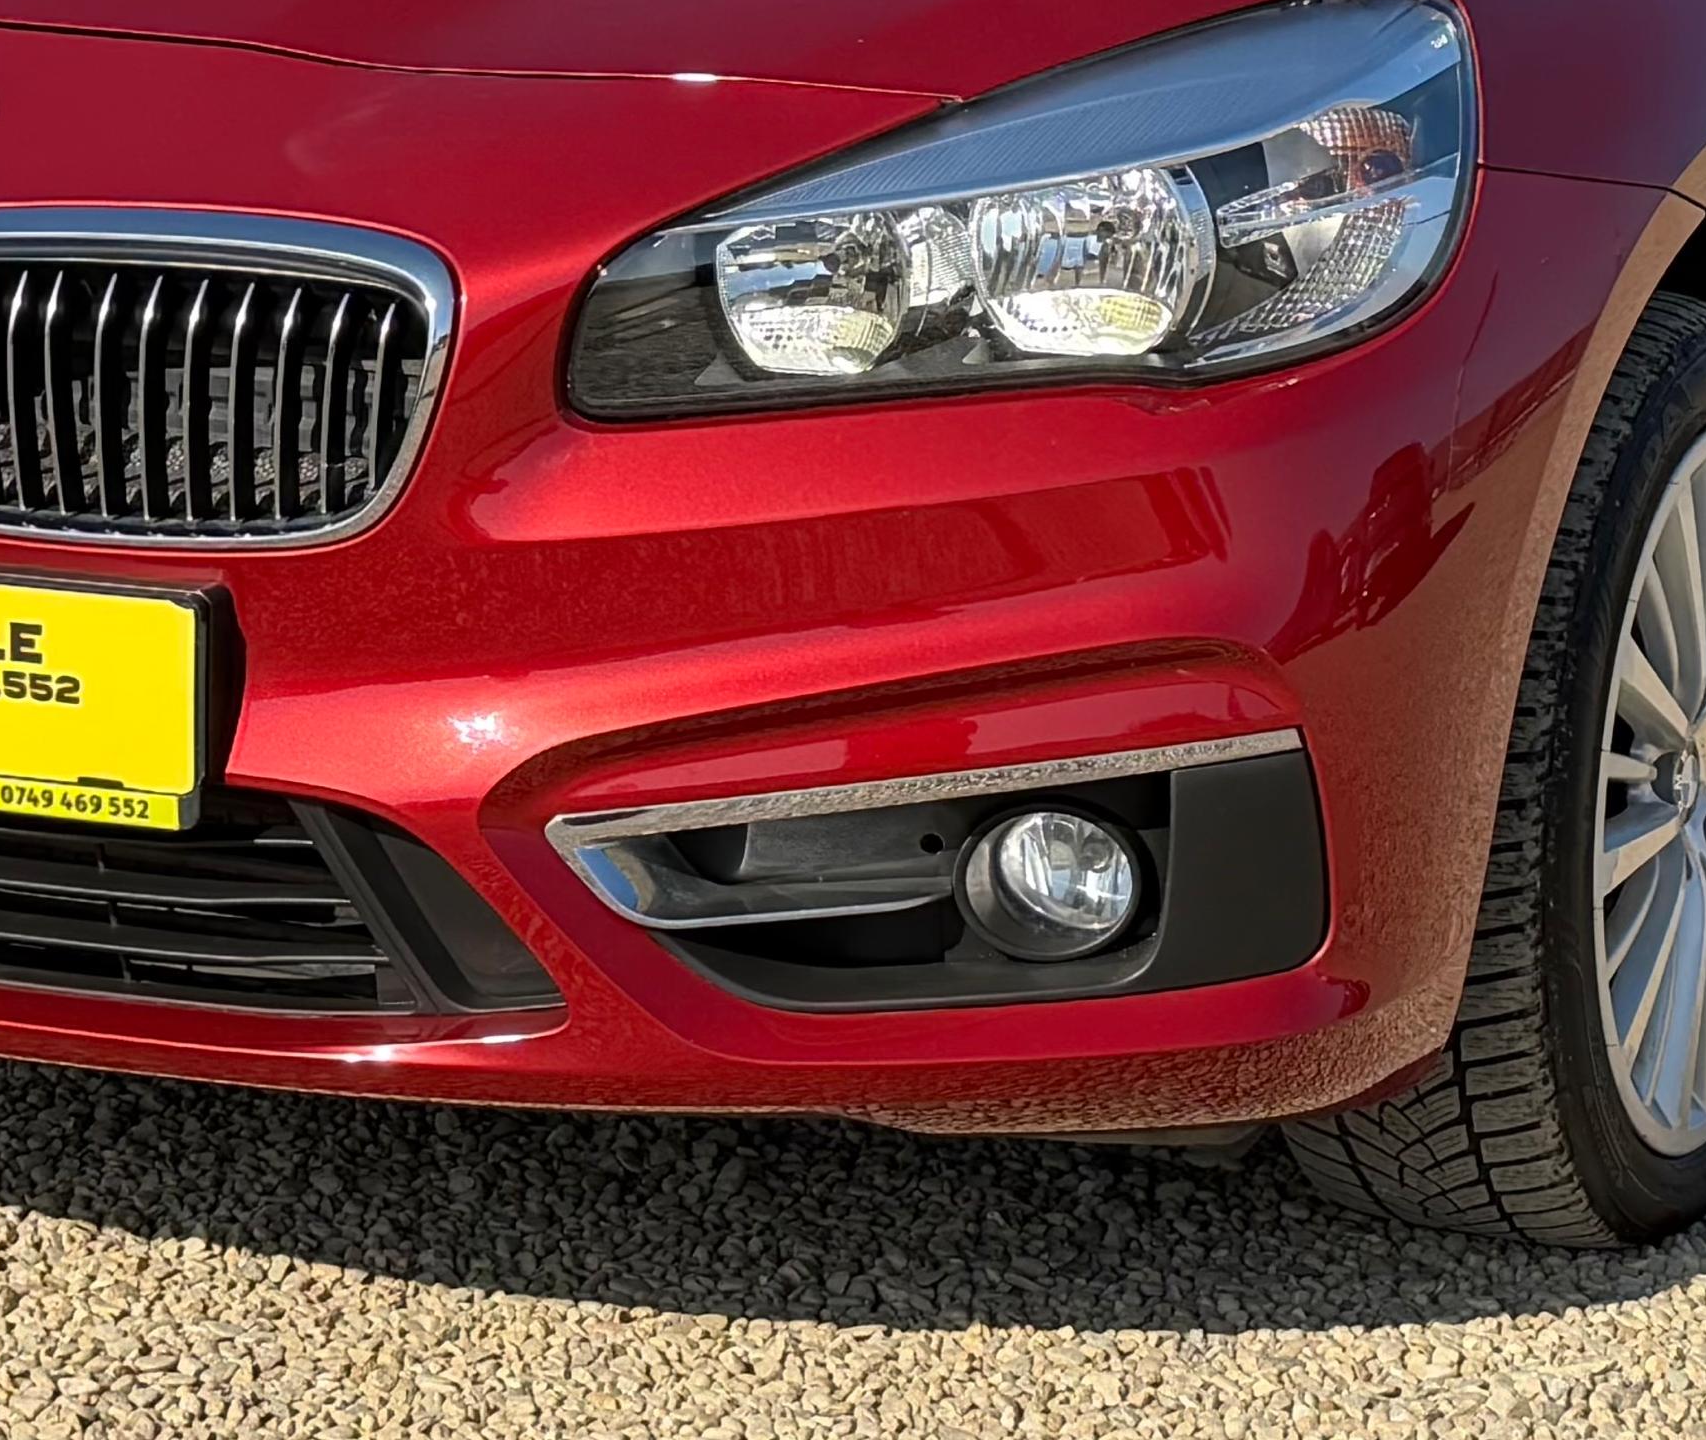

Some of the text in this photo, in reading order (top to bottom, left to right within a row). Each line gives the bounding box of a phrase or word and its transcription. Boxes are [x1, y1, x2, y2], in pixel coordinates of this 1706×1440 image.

[1, 785, 54, 808] 0749
[59, 791, 103, 814] 469
[108, 797, 150, 819] 552
